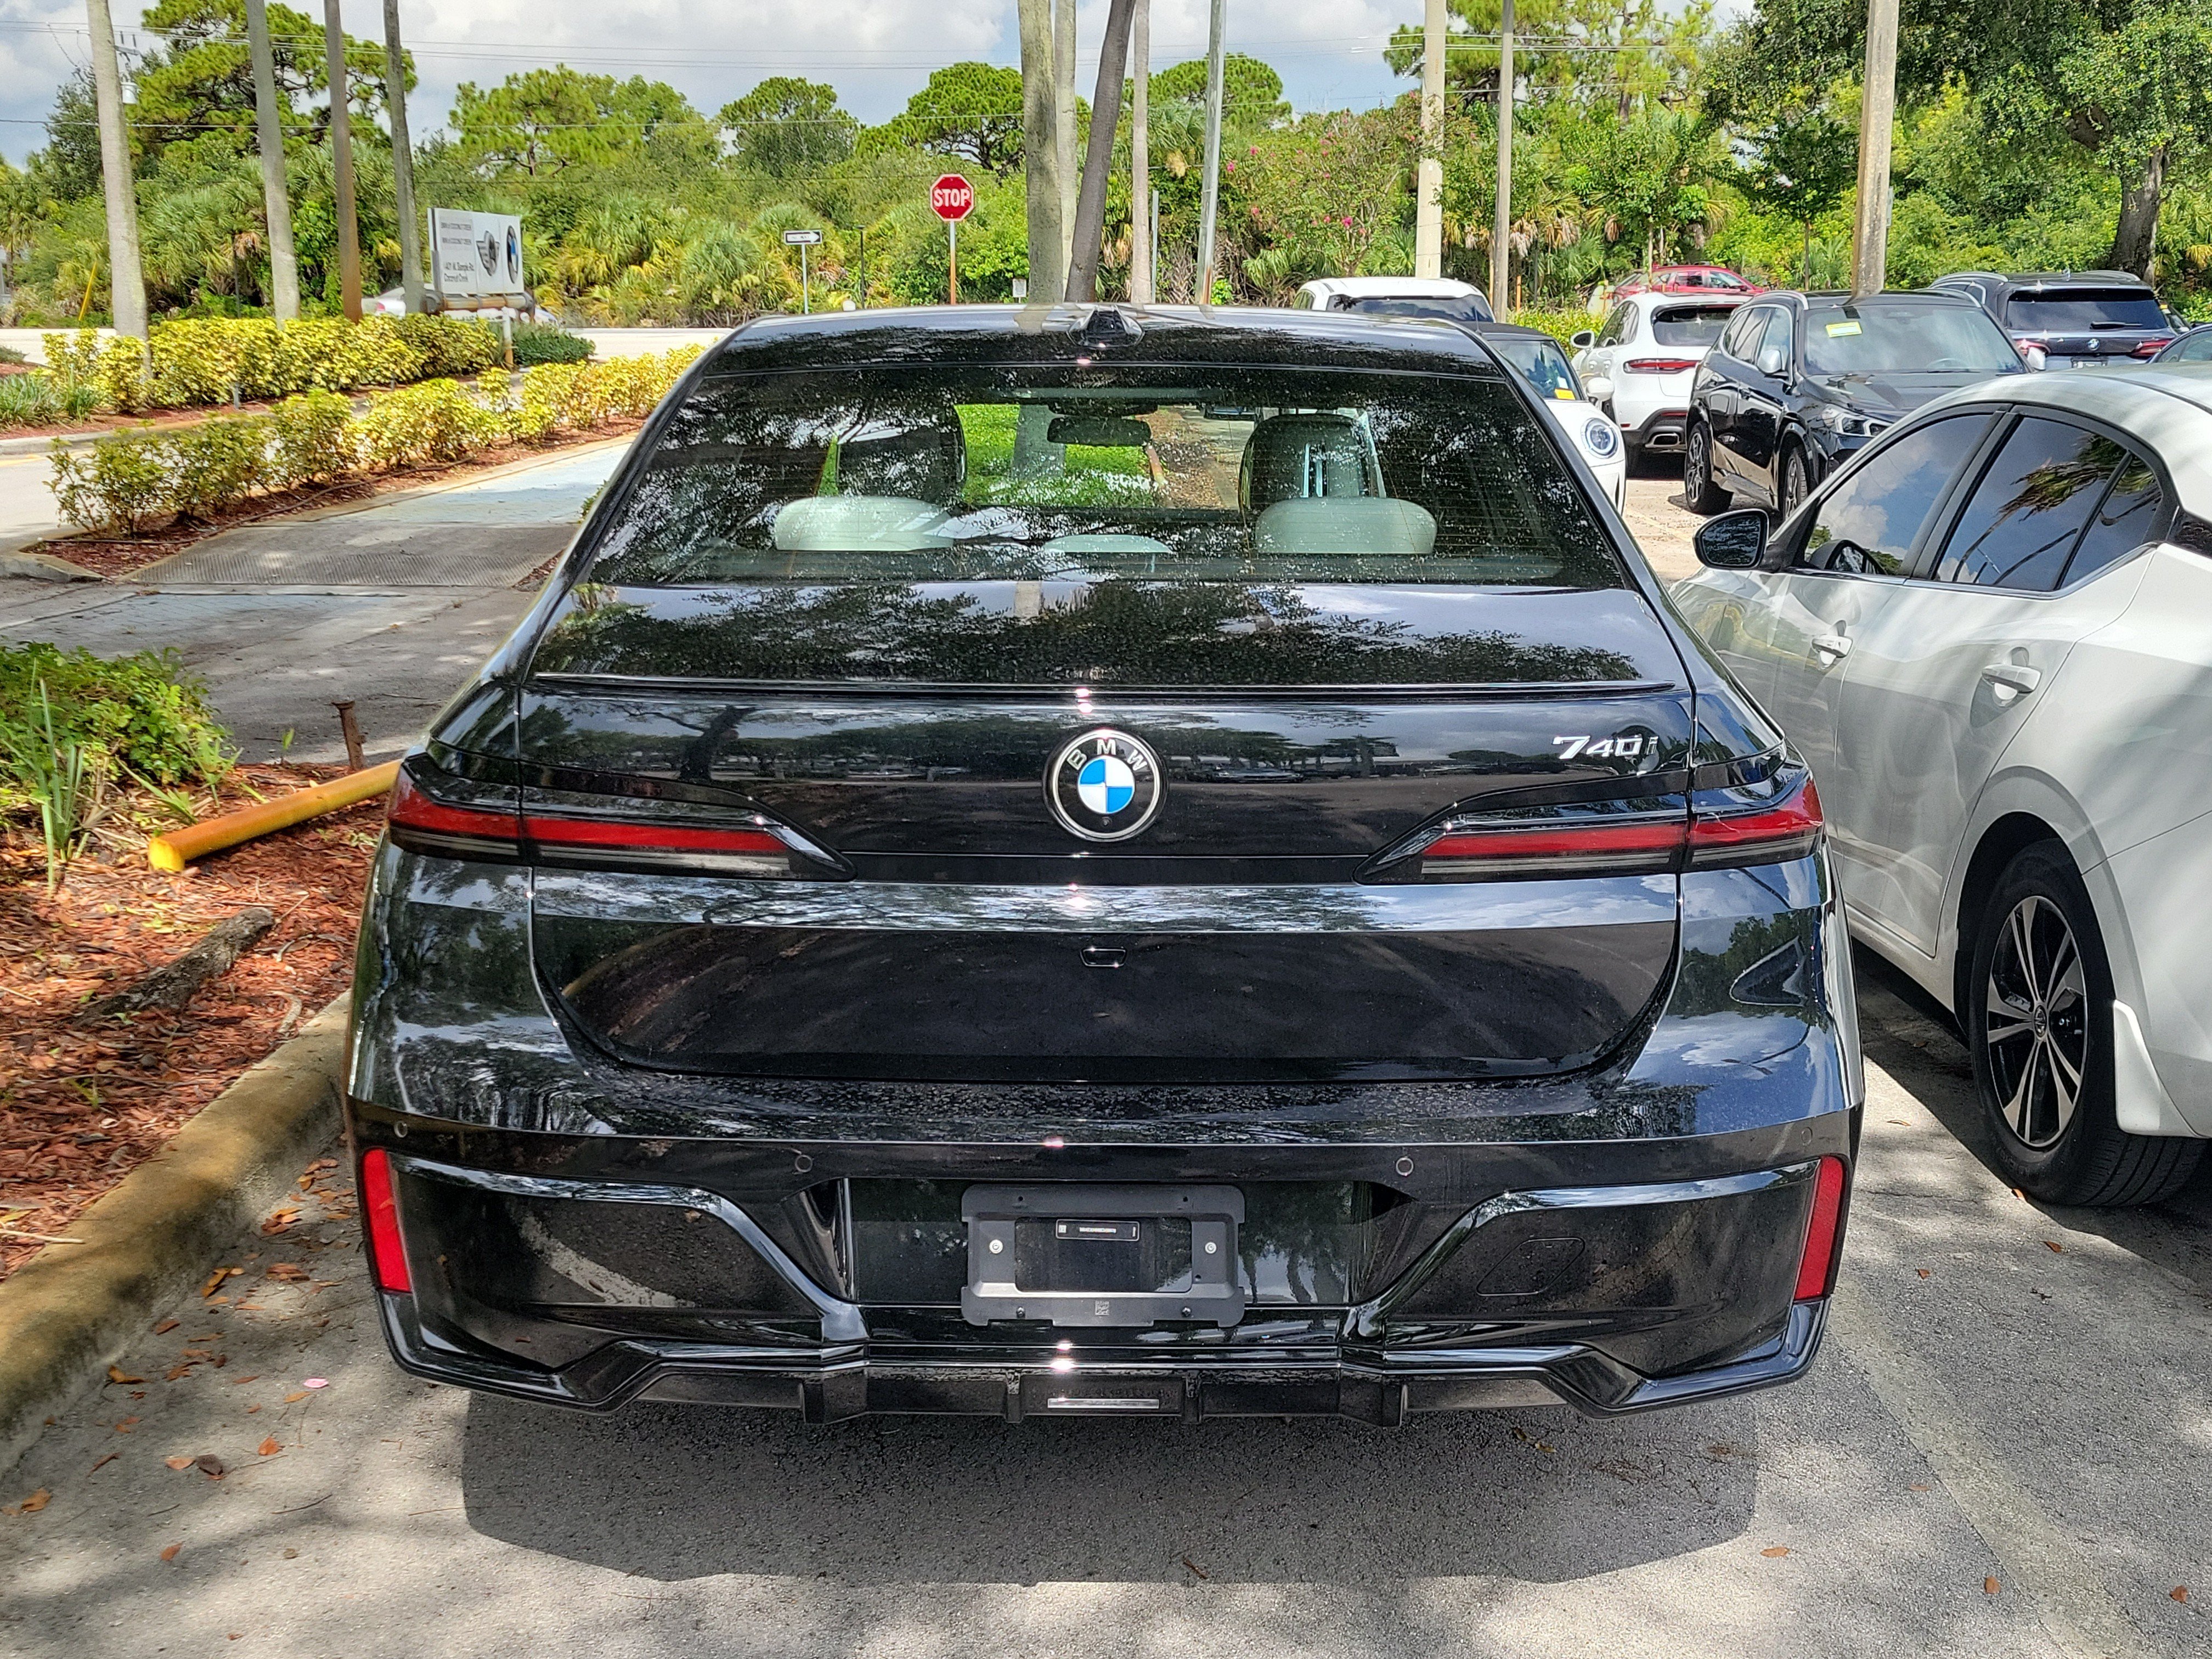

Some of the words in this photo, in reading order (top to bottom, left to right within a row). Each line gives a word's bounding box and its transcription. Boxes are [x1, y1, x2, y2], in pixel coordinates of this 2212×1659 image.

[933, 188, 970, 207] STOP
[1066, 739, 1148, 771] BMW
[1552, 734, 1658, 759] 740i
